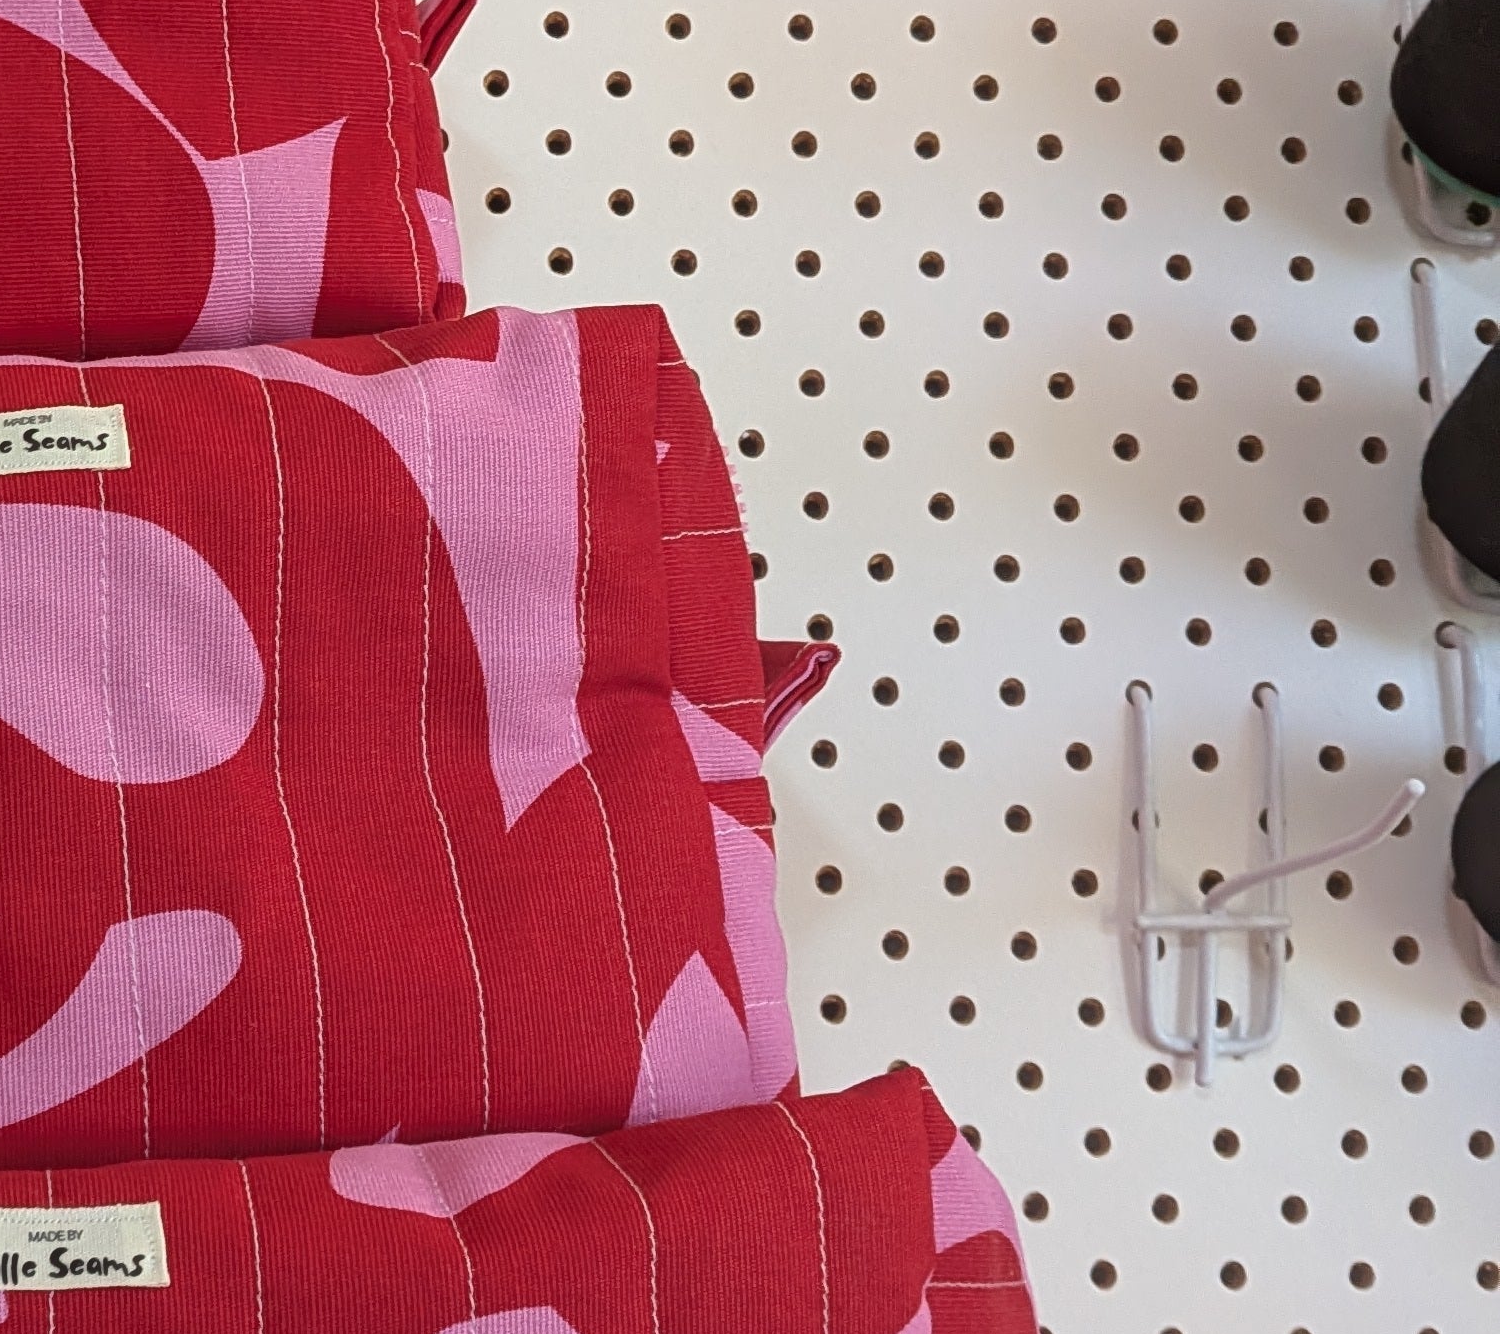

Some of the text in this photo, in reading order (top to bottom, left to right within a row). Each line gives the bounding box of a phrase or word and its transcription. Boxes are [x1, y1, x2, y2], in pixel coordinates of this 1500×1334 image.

[3, 416, 36, 427] MADE
[23, 428, 110, 452] Seams
[28, 1229, 84, 1243] MADE BY
[49, 1247, 146, 1278] Seams
